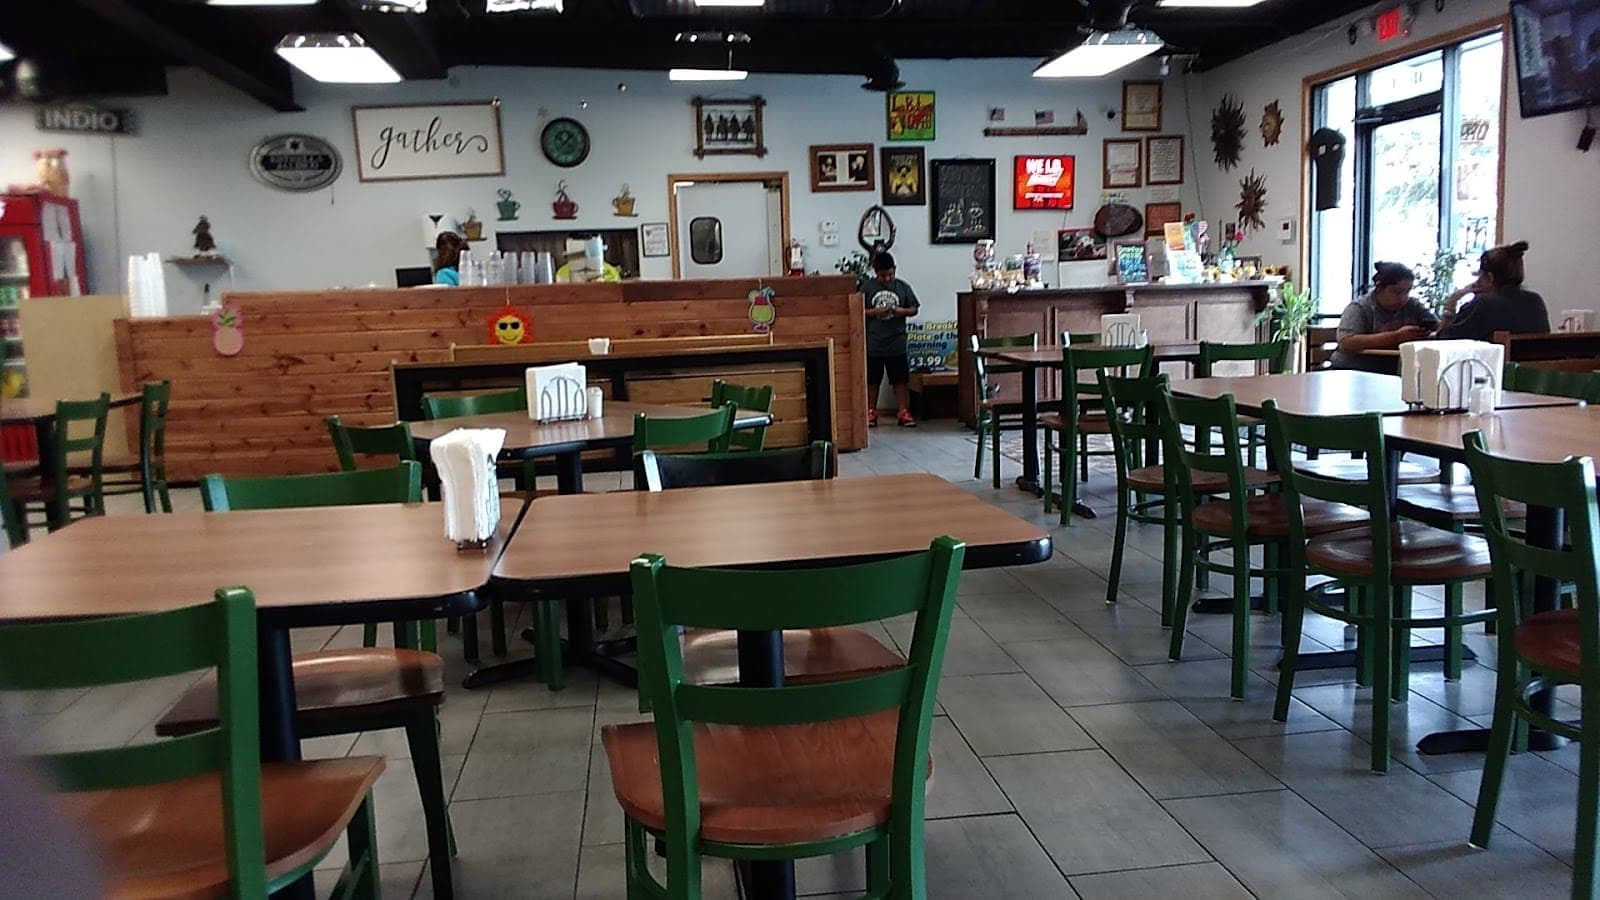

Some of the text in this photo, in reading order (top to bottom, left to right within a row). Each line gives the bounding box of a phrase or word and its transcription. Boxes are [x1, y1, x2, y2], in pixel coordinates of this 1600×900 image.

[44, 109, 118, 130] INDIO
[370, 116, 488, 170] gather
[908, 323, 923, 331] The
[908, 333, 932, 341] Plate
[934, 332, 944, 340] of
[908, 341, 947, 349] morning
[910, 355, 942, 366] $3.99
